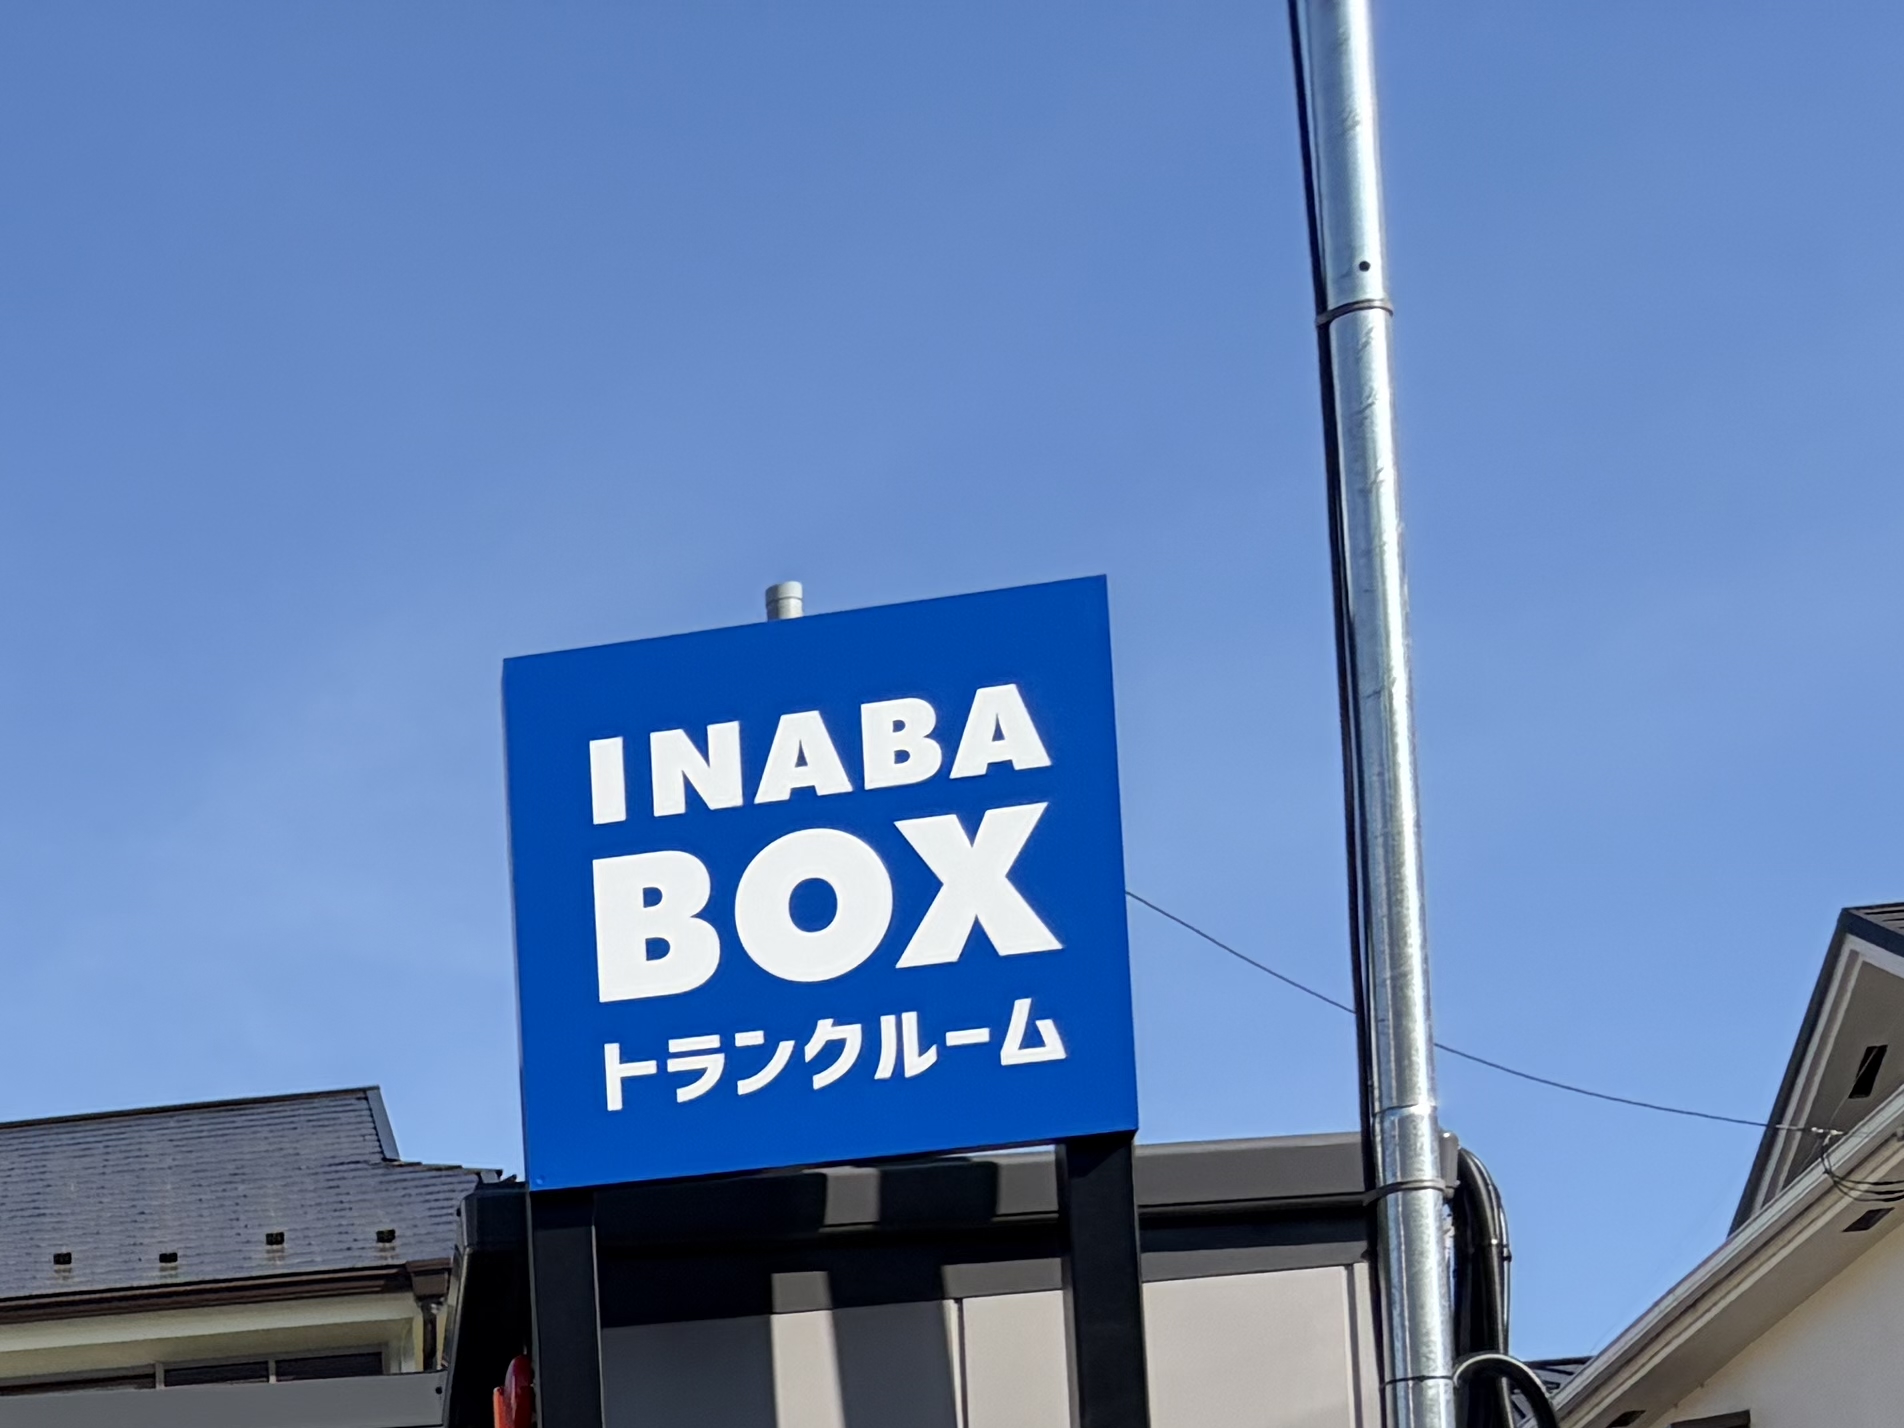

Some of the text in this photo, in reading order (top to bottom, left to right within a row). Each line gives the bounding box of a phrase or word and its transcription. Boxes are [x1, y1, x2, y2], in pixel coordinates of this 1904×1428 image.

[589, 683, 1052, 825] INABA
[592, 803, 1064, 1003] BOX
[604, 998, 1066, 1112] トランクルーム
